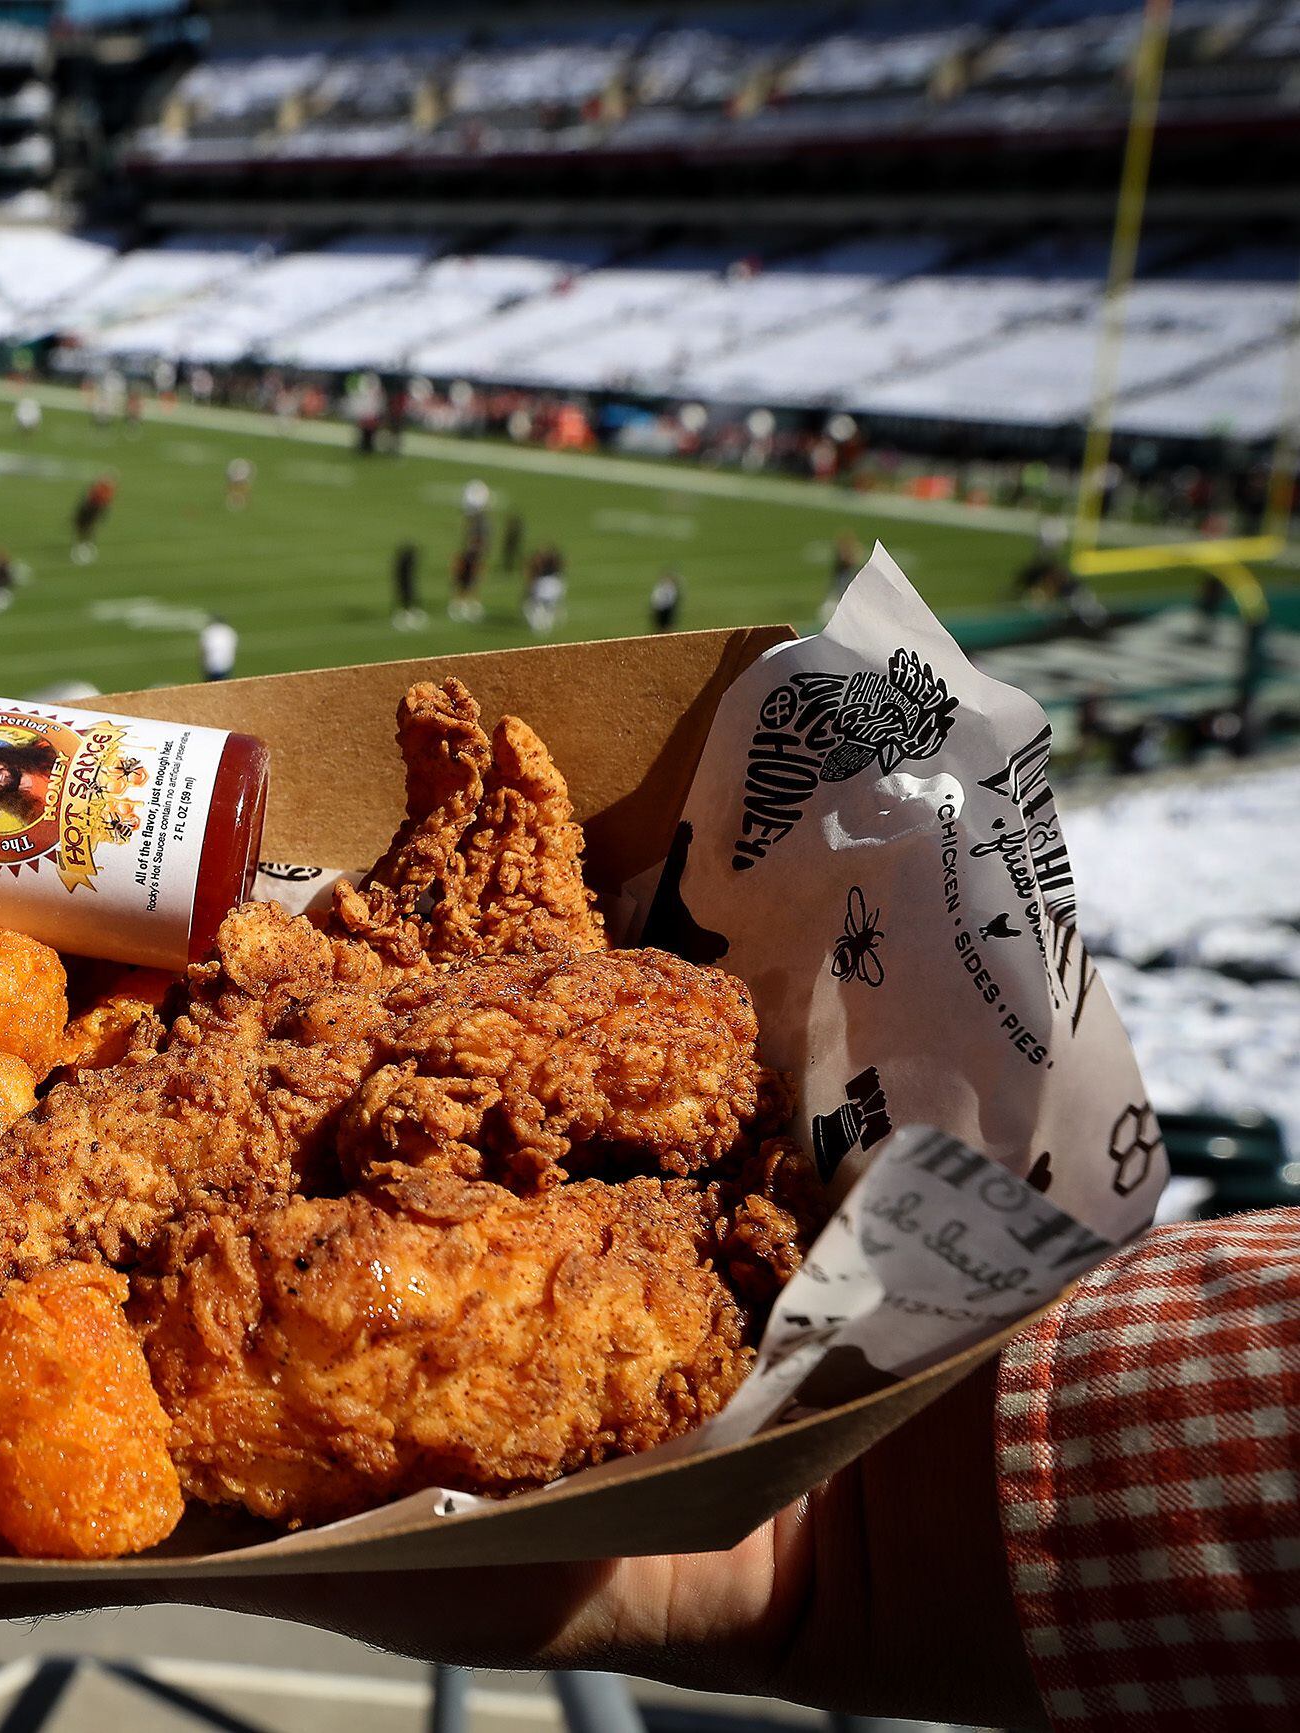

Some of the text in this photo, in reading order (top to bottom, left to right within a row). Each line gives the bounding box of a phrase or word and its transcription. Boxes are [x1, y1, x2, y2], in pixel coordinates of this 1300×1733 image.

[43, 751, 70, 822] HONEY
[155, 761, 169, 787] enough
[169, 758, 181, 790] artificial
[64, 733, 113, 866] HOT SAUCE
[149, 787, 162, 810] just
[165, 791, 175, 802] no
[174, 776, 198, 842] 2 FL OZ (59 ml)
[145, 808, 160, 841] flavor,
[161, 802, 172, 830] contain
[1, 835, 34, 852] The
[143, 841, 152, 856] the
[155, 831, 168, 864] Sauces
[140, 857, 149, 870] of
[152, 864, 162, 881] Hot
[969, 828, 1037, 899] fried
[135, 871, 146, 886] All
[147, 882, 160, 911] Rocky's
[937, 803, 961, 914] CHICKEN
[954, 930, 1001, 1006] SIDES
[1000, 1011, 1049, 1067] PIES
